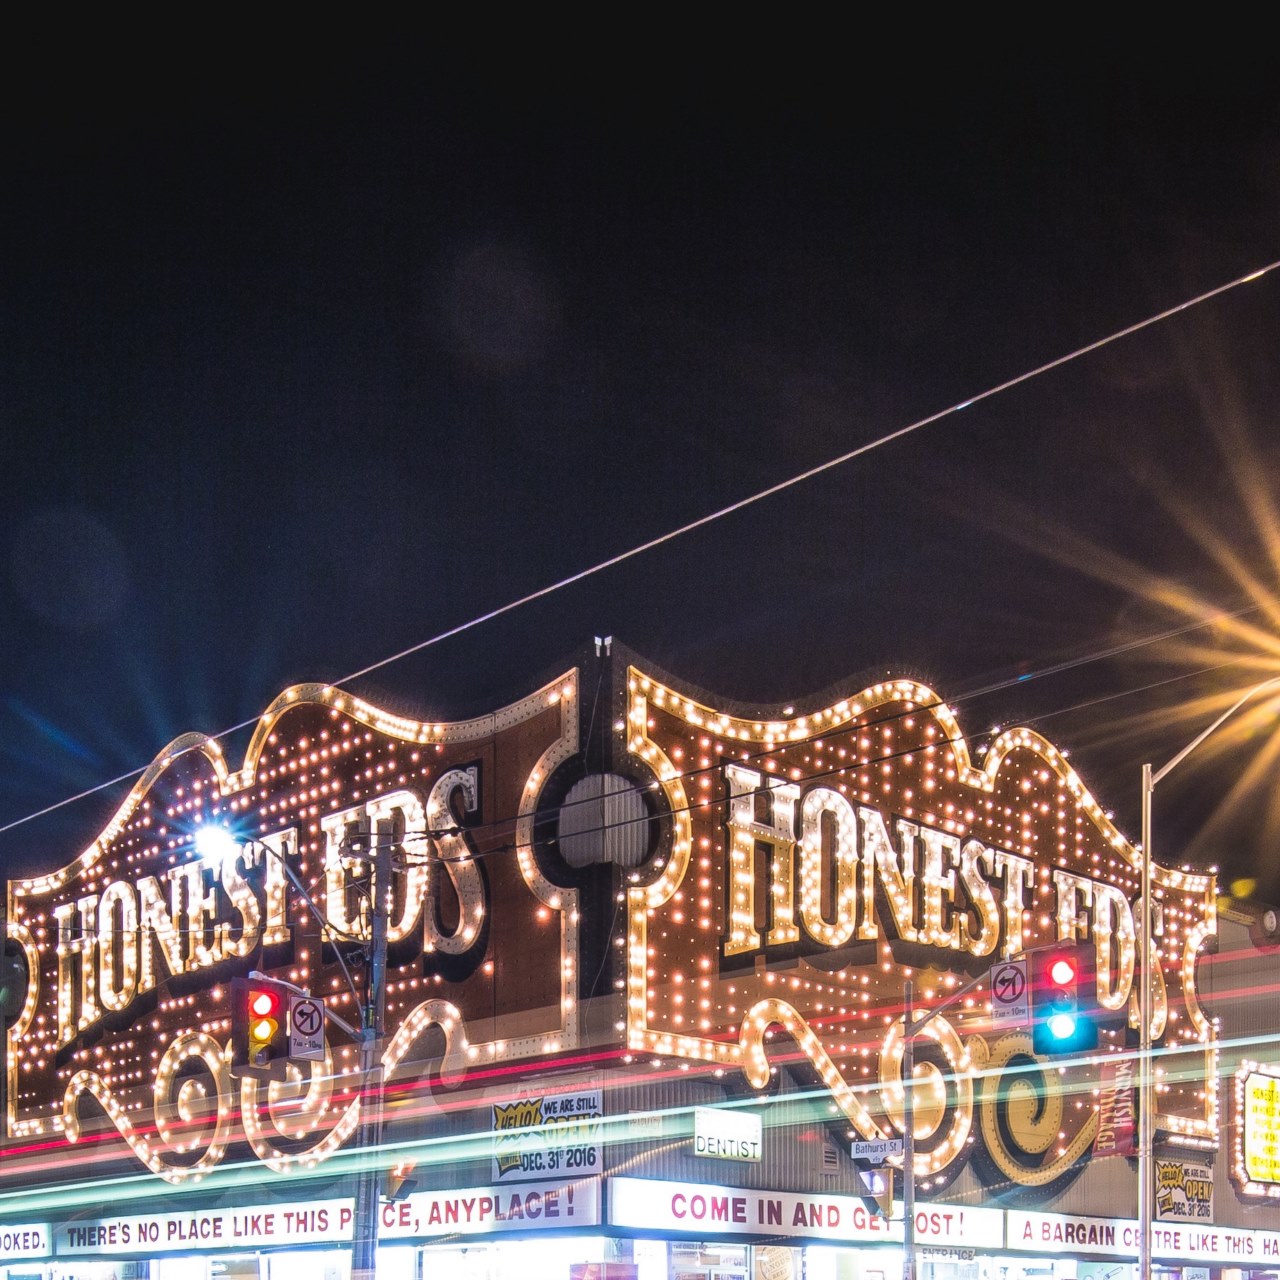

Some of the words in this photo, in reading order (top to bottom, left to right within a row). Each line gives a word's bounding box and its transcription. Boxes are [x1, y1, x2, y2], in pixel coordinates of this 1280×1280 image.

[723, 764, 1034, 957] HONEST
[55, 827, 299, 1045] HONEST
[1115, 1061, 1132, 1128] MIRVISH
[501, 1109, 538, 1131] HELLO!
[544, 1101, 557, 1115] WE
[560, 1099, 575, 1112] ARE
[576, 1097, 598, 1111] STILL
[1098, 1086, 1117, 1151] VILLAGE
[522, 1152, 546, 1172] DEC.
[566, 1147, 596, 1168] 2016
[697, 1136, 759, 1159] DENTIST
[856, 1142, 887, 1154] Bathurst
[889, 1141, 897, 1152] St
[1161, 1166, 1181, 1181] HELLO!
[1185, 1180, 1213, 1202] OPEN!
[68, 1221, 131, 1248] THERE'S
[138, 1222, 159, 1243] NO
[168, 1216, 223, 1241] PLACE
[233, 1213, 275, 1237] LIKE
[283, 1208, 329, 1234] THIS
[340, 1203, 420, 1233] PCE,
[671, 1193, 747, 1224] COME
[758, 1199, 783, 1226] IN
[792, 1201, 841, 1229] AND
[1197, 1203, 1211, 1217] 2016
[1023, 1220, 1033, 1241] A
[1042, 1222, 1115, 1247] BARGAIN
[1123, 1228, 1182, 1251] CETRE
[1188, 1233, 1219, 1253] LIKE
[1224, 1235, 1254, 1255] THIS
